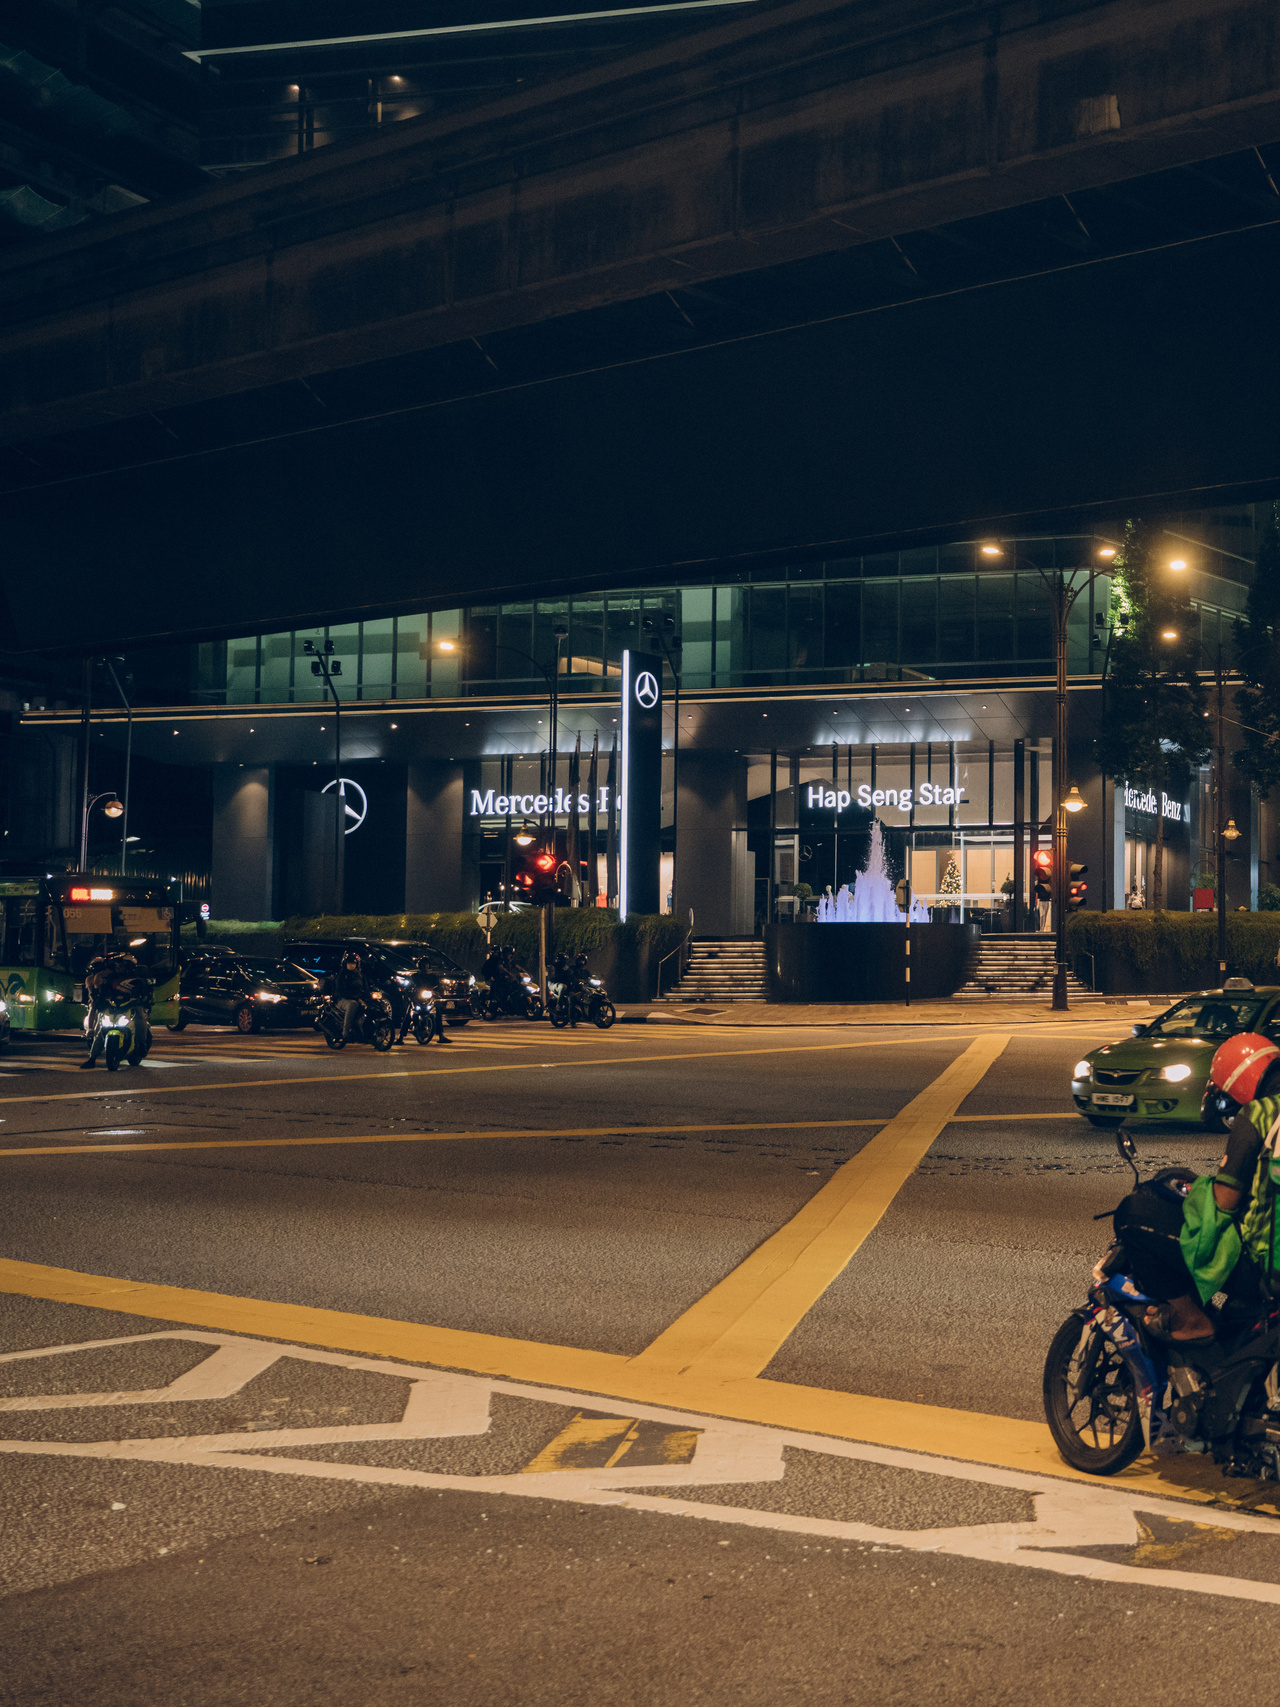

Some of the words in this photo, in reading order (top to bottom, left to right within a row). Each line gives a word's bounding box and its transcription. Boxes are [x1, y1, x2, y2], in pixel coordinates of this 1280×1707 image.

[808, 785, 851, 813] Hap
[857, 784, 913, 812] Seng
[919, 782, 966, 806] Star
